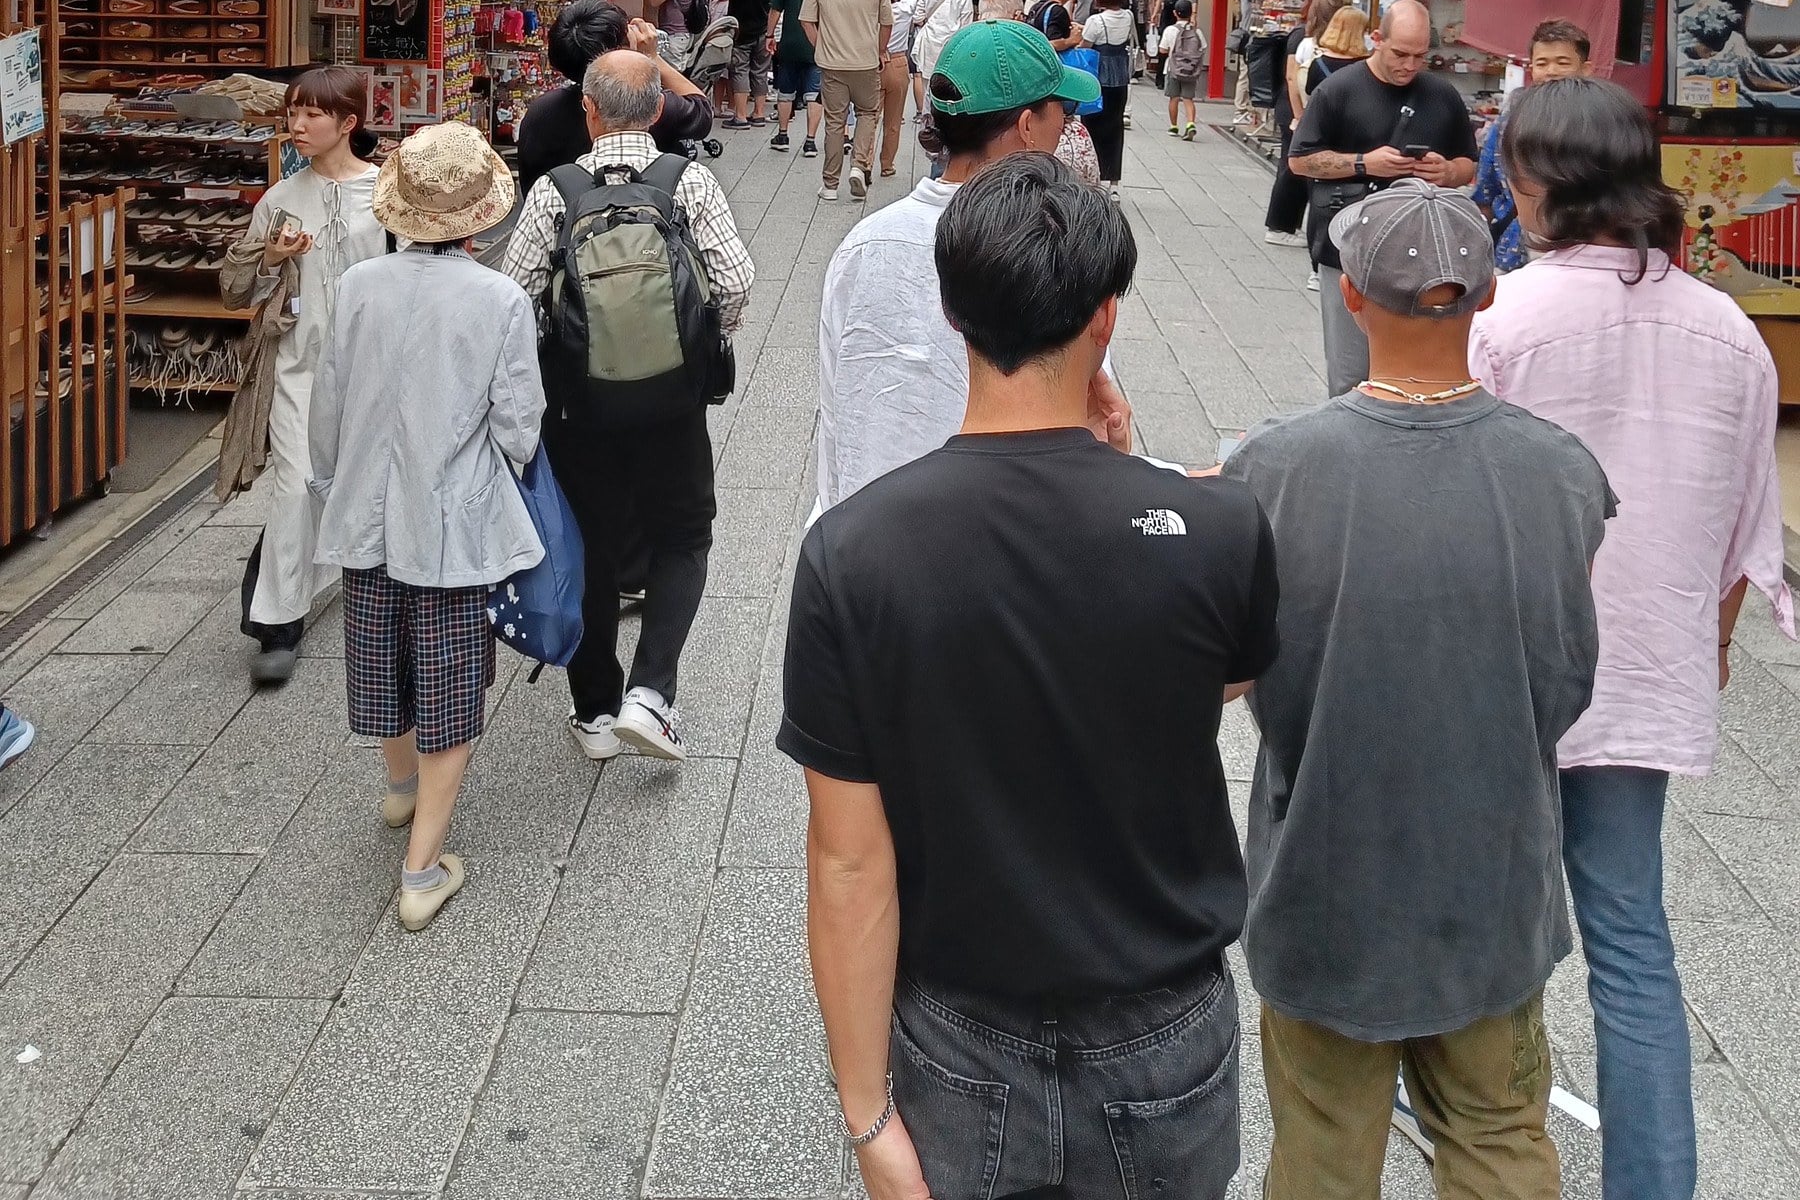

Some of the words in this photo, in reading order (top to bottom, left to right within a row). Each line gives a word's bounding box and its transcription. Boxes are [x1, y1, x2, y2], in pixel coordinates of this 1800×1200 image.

[1146, 509, 1166, 519] THE
[1131, 516, 1167, 527] NORTH
[1143, 526, 1168, 535] FACE
